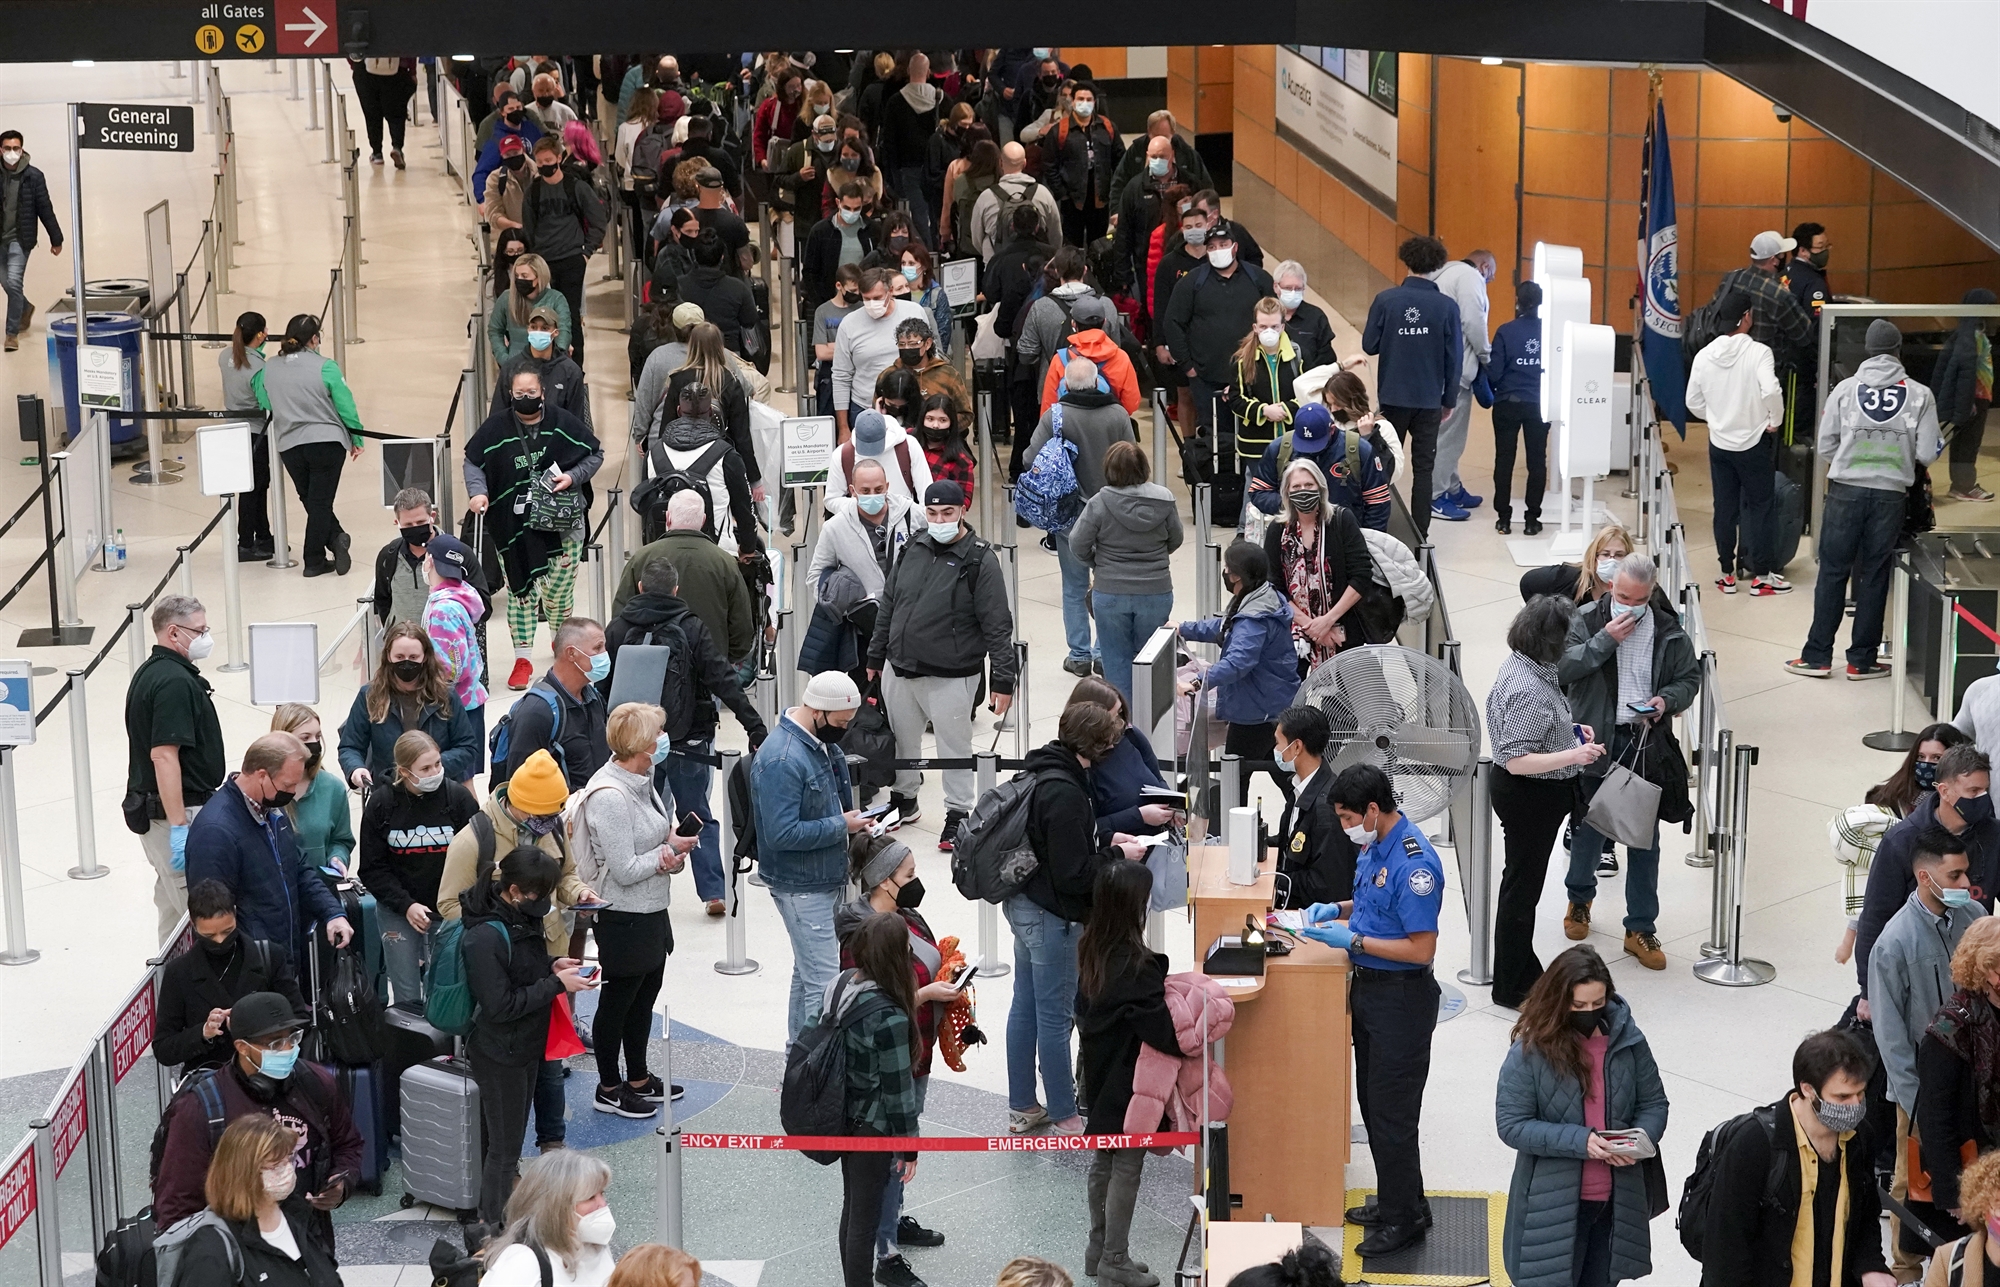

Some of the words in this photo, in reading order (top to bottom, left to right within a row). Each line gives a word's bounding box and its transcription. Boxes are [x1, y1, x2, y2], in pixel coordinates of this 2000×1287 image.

[201, 4, 219, 19] all
[223, 4, 265, 19] Gates
[1287, 72, 1312, 106] Acumatica
[108, 107, 170, 125] General
[100, 127, 179, 149] Screening
[1398, 326, 1429, 335] CLEAR
[1516, 357, 1541, 366] CLEA
[1863, 387, 1899, 412] 35
[1303, 426, 1313, 438] LA
[112, 985, 151, 1053] EMERGENCY
[116, 1037, 132, 1077] EXIT
[133, 1015, 151, 1056] ONLY
[52, 1073, 83, 1149] EMERGENCY
[55, 1131, 68, 1175] EXIT
[68, 1104, 83, 1150] ONLY
[728, 1136, 764, 1149] EXIT
[987, 1136, 1092, 1151] EMERGENCY
[1096, 1135, 1132, 1149] EXIT
[8, 1184, 30, 1232] ONLY
